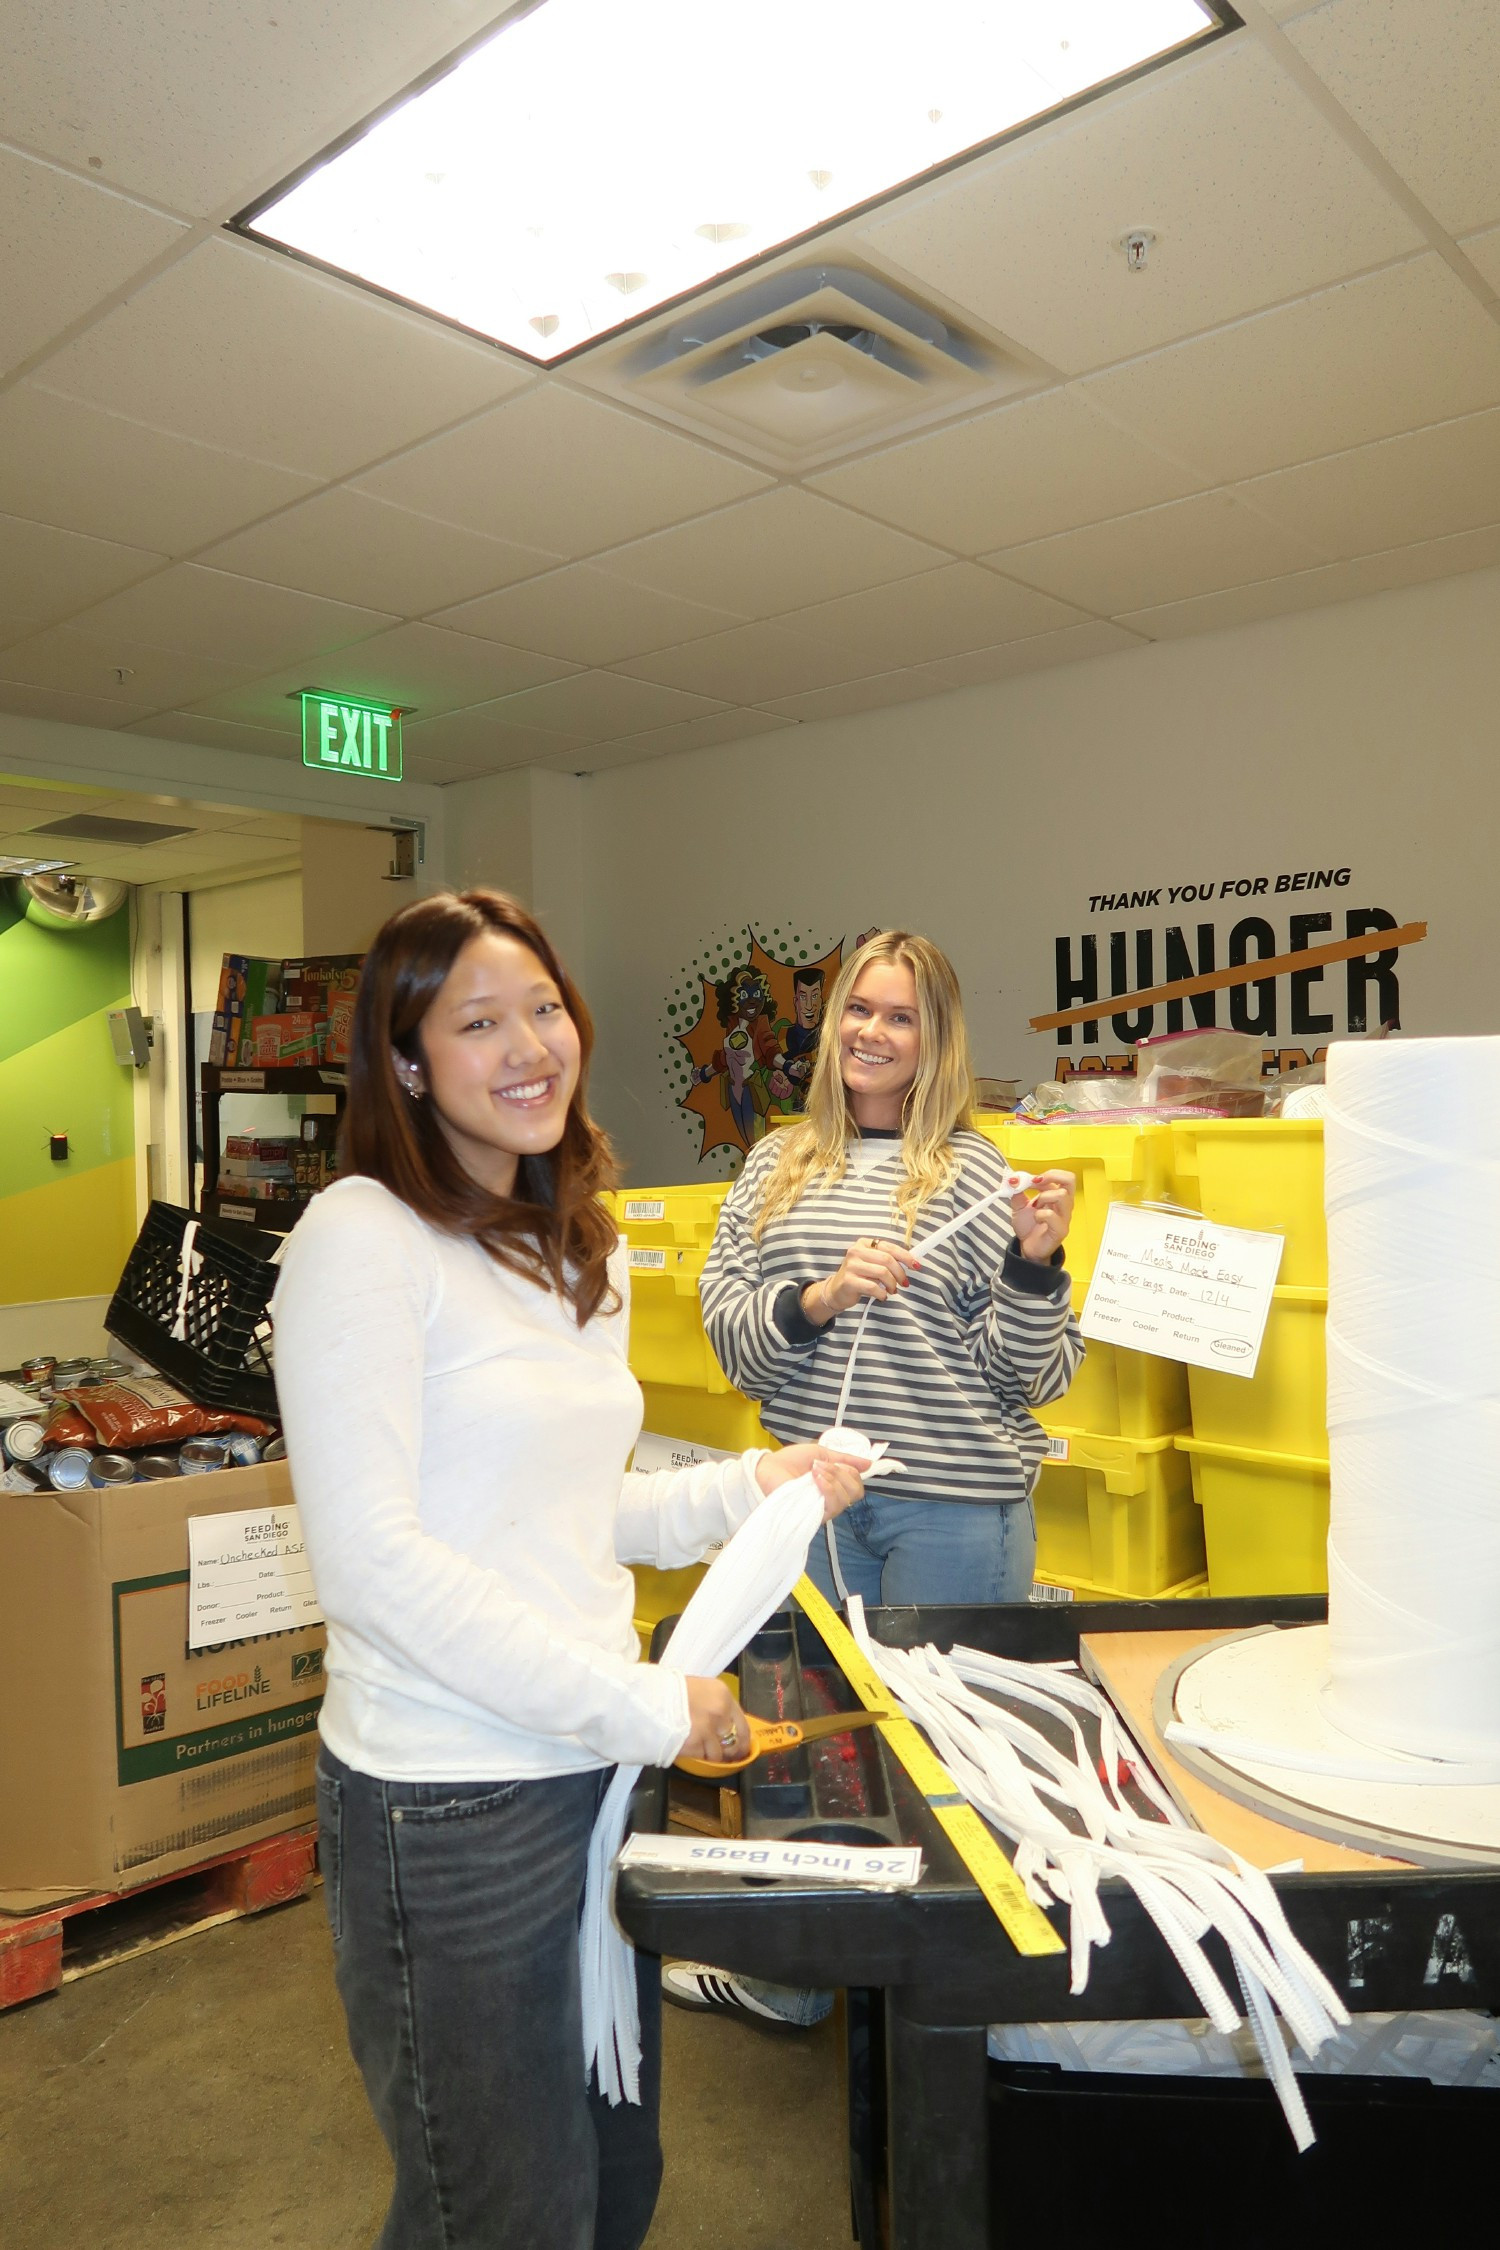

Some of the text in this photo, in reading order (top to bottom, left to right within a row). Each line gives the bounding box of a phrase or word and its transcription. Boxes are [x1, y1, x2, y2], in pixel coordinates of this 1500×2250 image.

[320, 702, 392, 771] EXIT
[1088, 867, 1352, 912] THANK YOU FOR BEING
[1054, 907, 1402, 1046] HUNGER
[1165, 1232, 1218, 1251] FEEDING
[1163, 1242, 1183, 1253] SAN
[1185, 1246, 1216, 1260] DIEGO
[1121, 1273, 1140, 1285] 250
[1093, 1293, 1120, 1306] Donor:
[1169, 1286, 1191, 1298] Date:
[1161, 1310, 1196, 1325] Product:
[1093, 1310, 1247, 1354] Freezer Cooler Return Gleaned
[244, 1521, 290, 1535] FEEDING
[244, 1533, 261, 1542] SAN
[263, 1530, 289, 1540] DIEGO
[197, 1558, 219, 1567] Name:
[258, 1570, 276, 1579] Date:
[256, 1590, 285, 1601] Product:
[200, 1617, 227, 1627] Freezer
[235, 1610, 259, 1620] Cooler
[269, 1604, 292, 1614] Return
[195, 1672, 250, 1697] FOOD
[196, 1679, 272, 1711] LIFELINE
[176, 1732, 244, 1760] Partners
[249, 1725, 262, 1739] in
[691, 1846, 908, 1873] 26 Inch Bags
